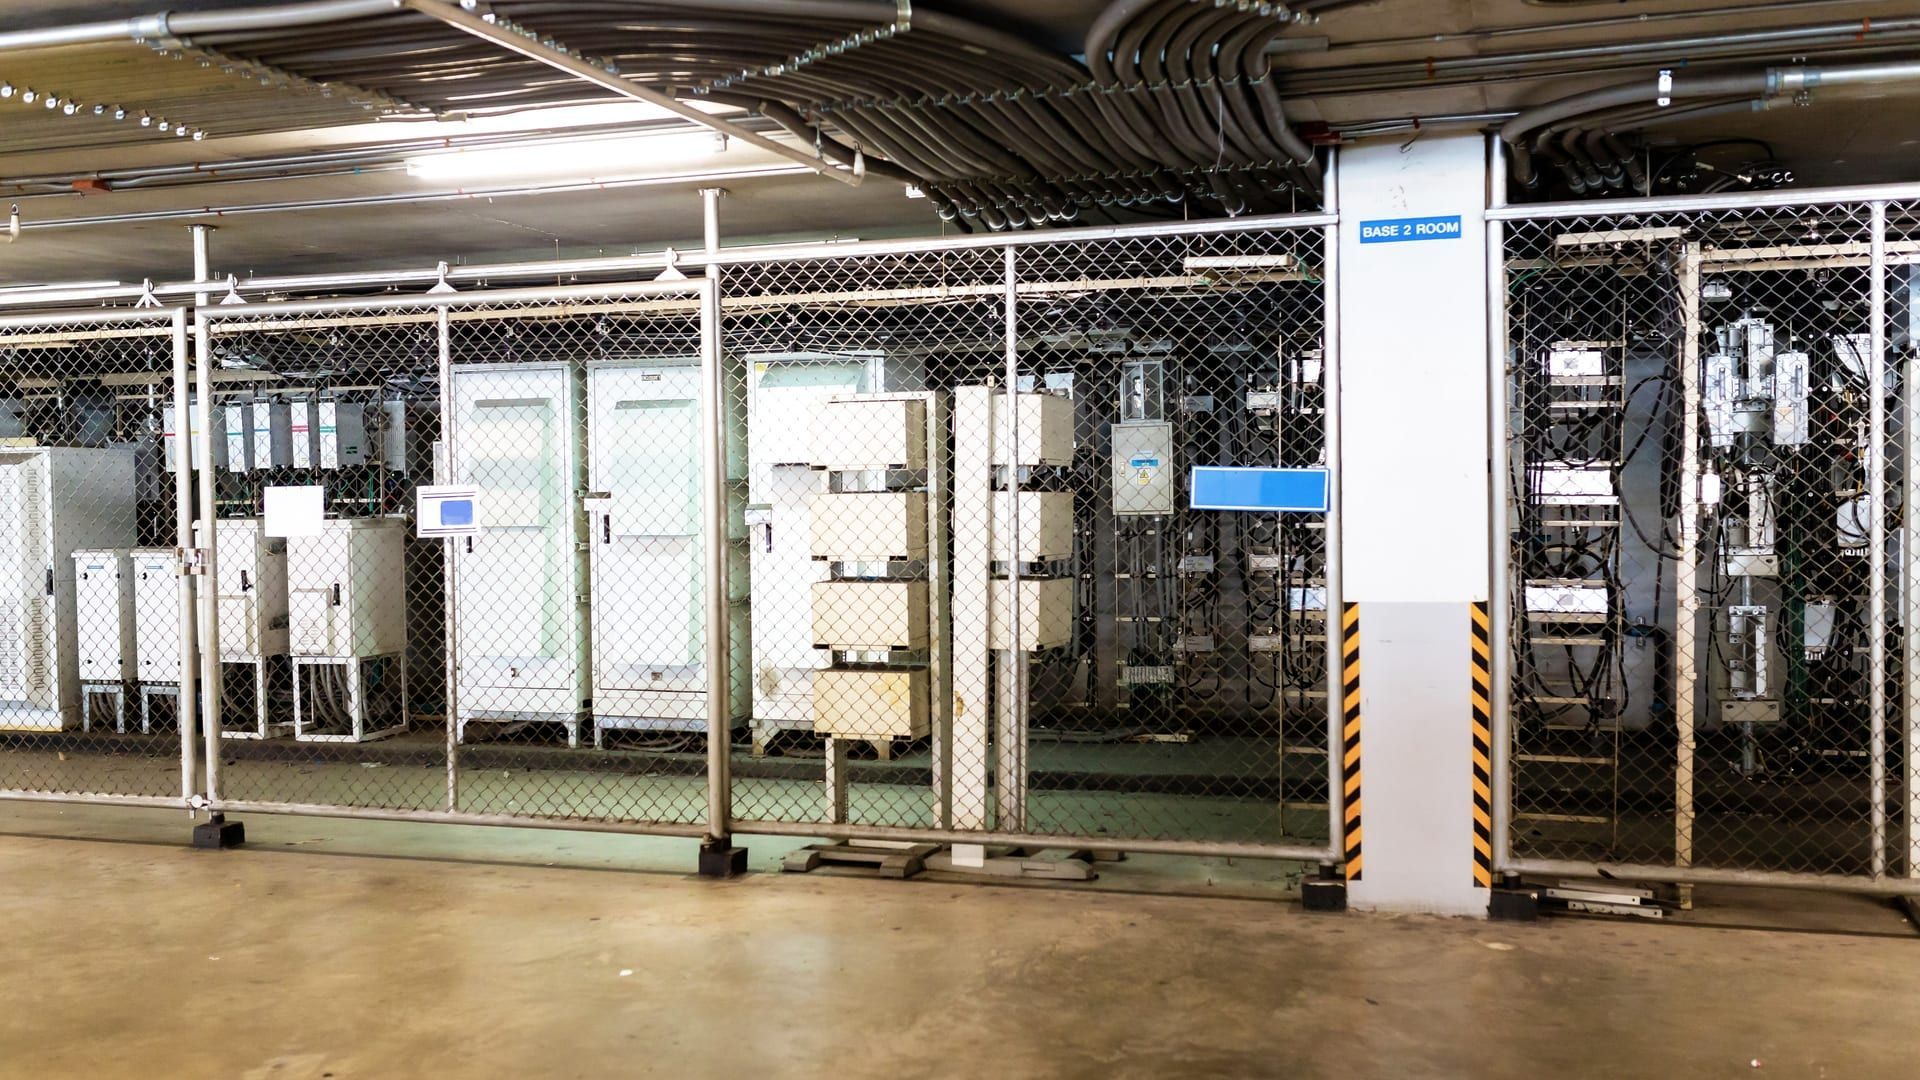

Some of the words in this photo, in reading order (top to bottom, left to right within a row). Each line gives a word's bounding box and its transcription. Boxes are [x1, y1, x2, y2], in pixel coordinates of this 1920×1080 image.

[1363, 225, 1399, 238] BASE
[1403, 225, 1411, 236] 2
[1416, 222, 1459, 235] ROOM
